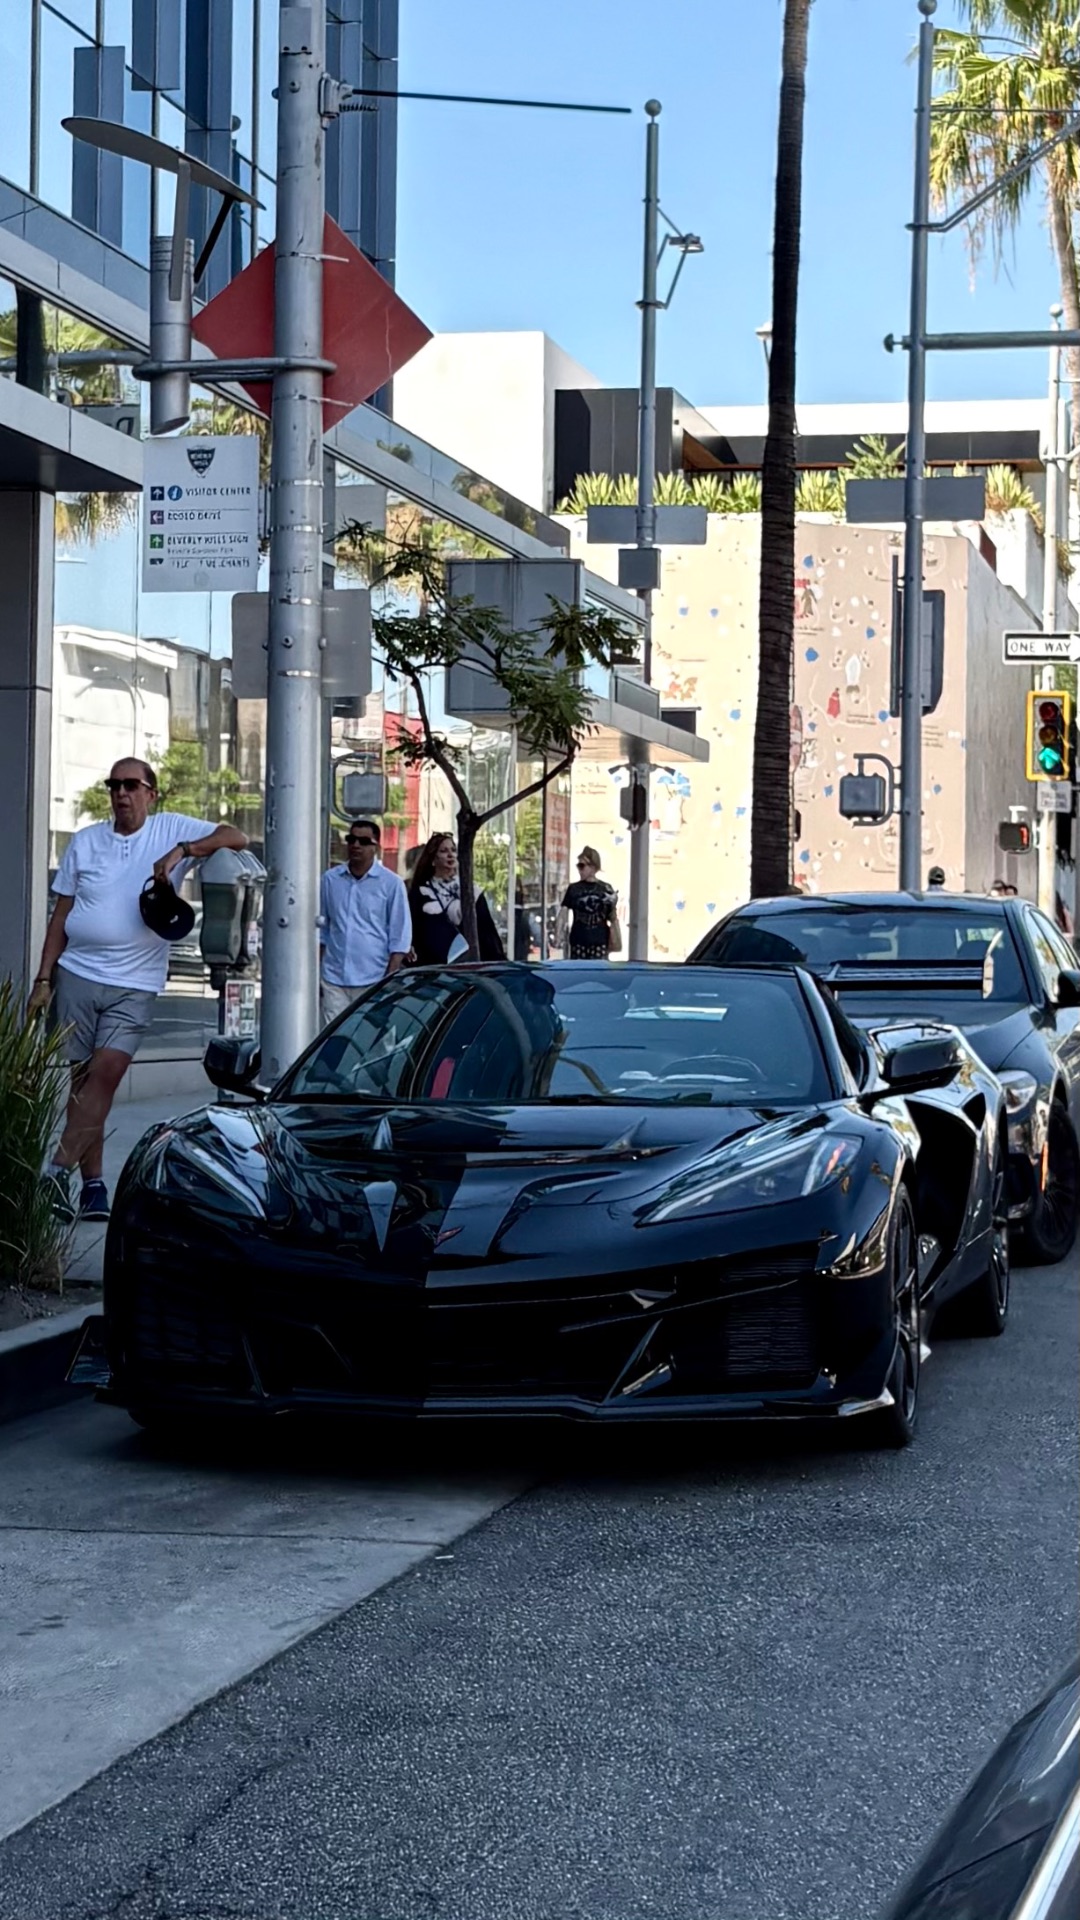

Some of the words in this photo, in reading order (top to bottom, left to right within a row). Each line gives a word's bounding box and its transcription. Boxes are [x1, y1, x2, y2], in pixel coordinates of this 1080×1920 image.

[186, 487, 217, 496] VISITOR
[220, 487, 251, 496] CENTER
[1010, 641, 1035, 653] ONE
[1045, 642, 1071, 652] WAY
